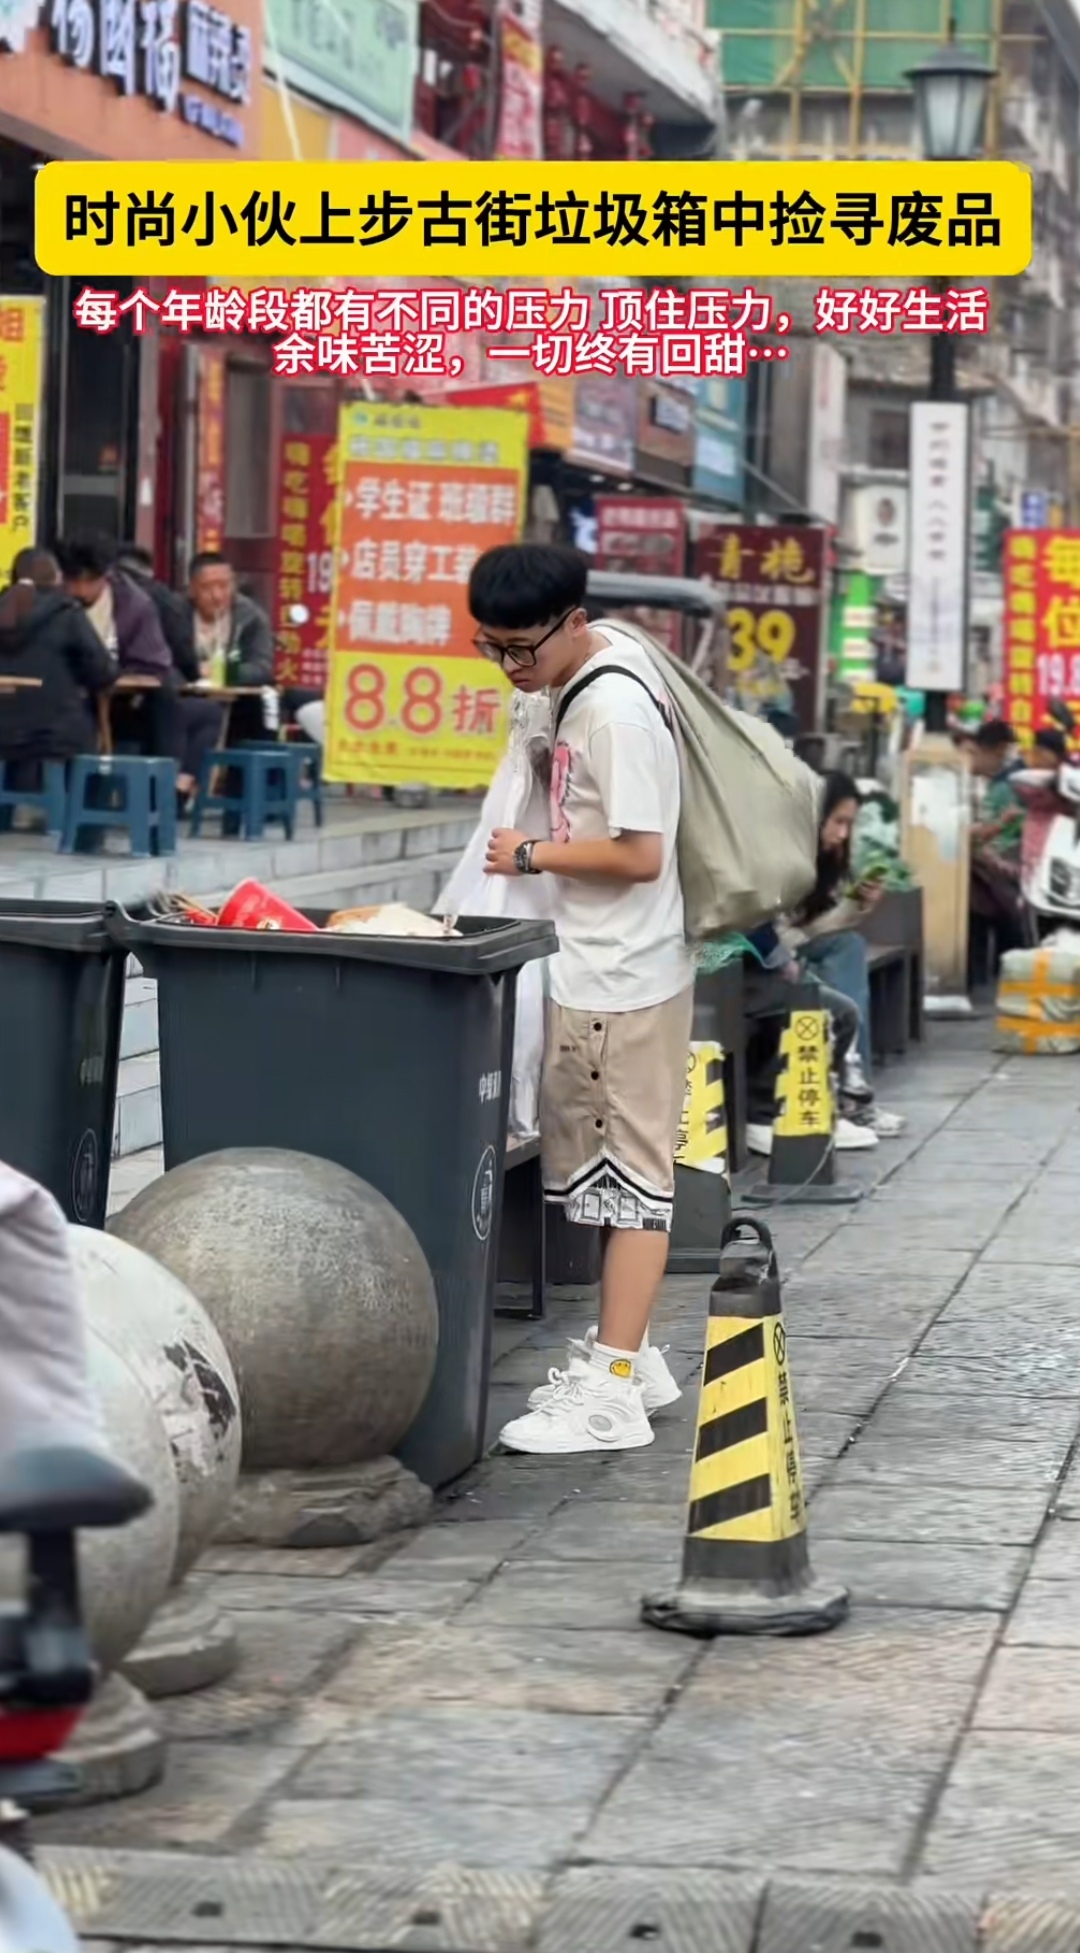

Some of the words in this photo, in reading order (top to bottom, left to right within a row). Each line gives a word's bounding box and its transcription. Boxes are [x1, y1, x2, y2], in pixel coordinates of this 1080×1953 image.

[355, 477, 433, 522] 学生证
[726, 607, 796, 672] 39
[797, 1045, 823, 1128] 禁止停车
